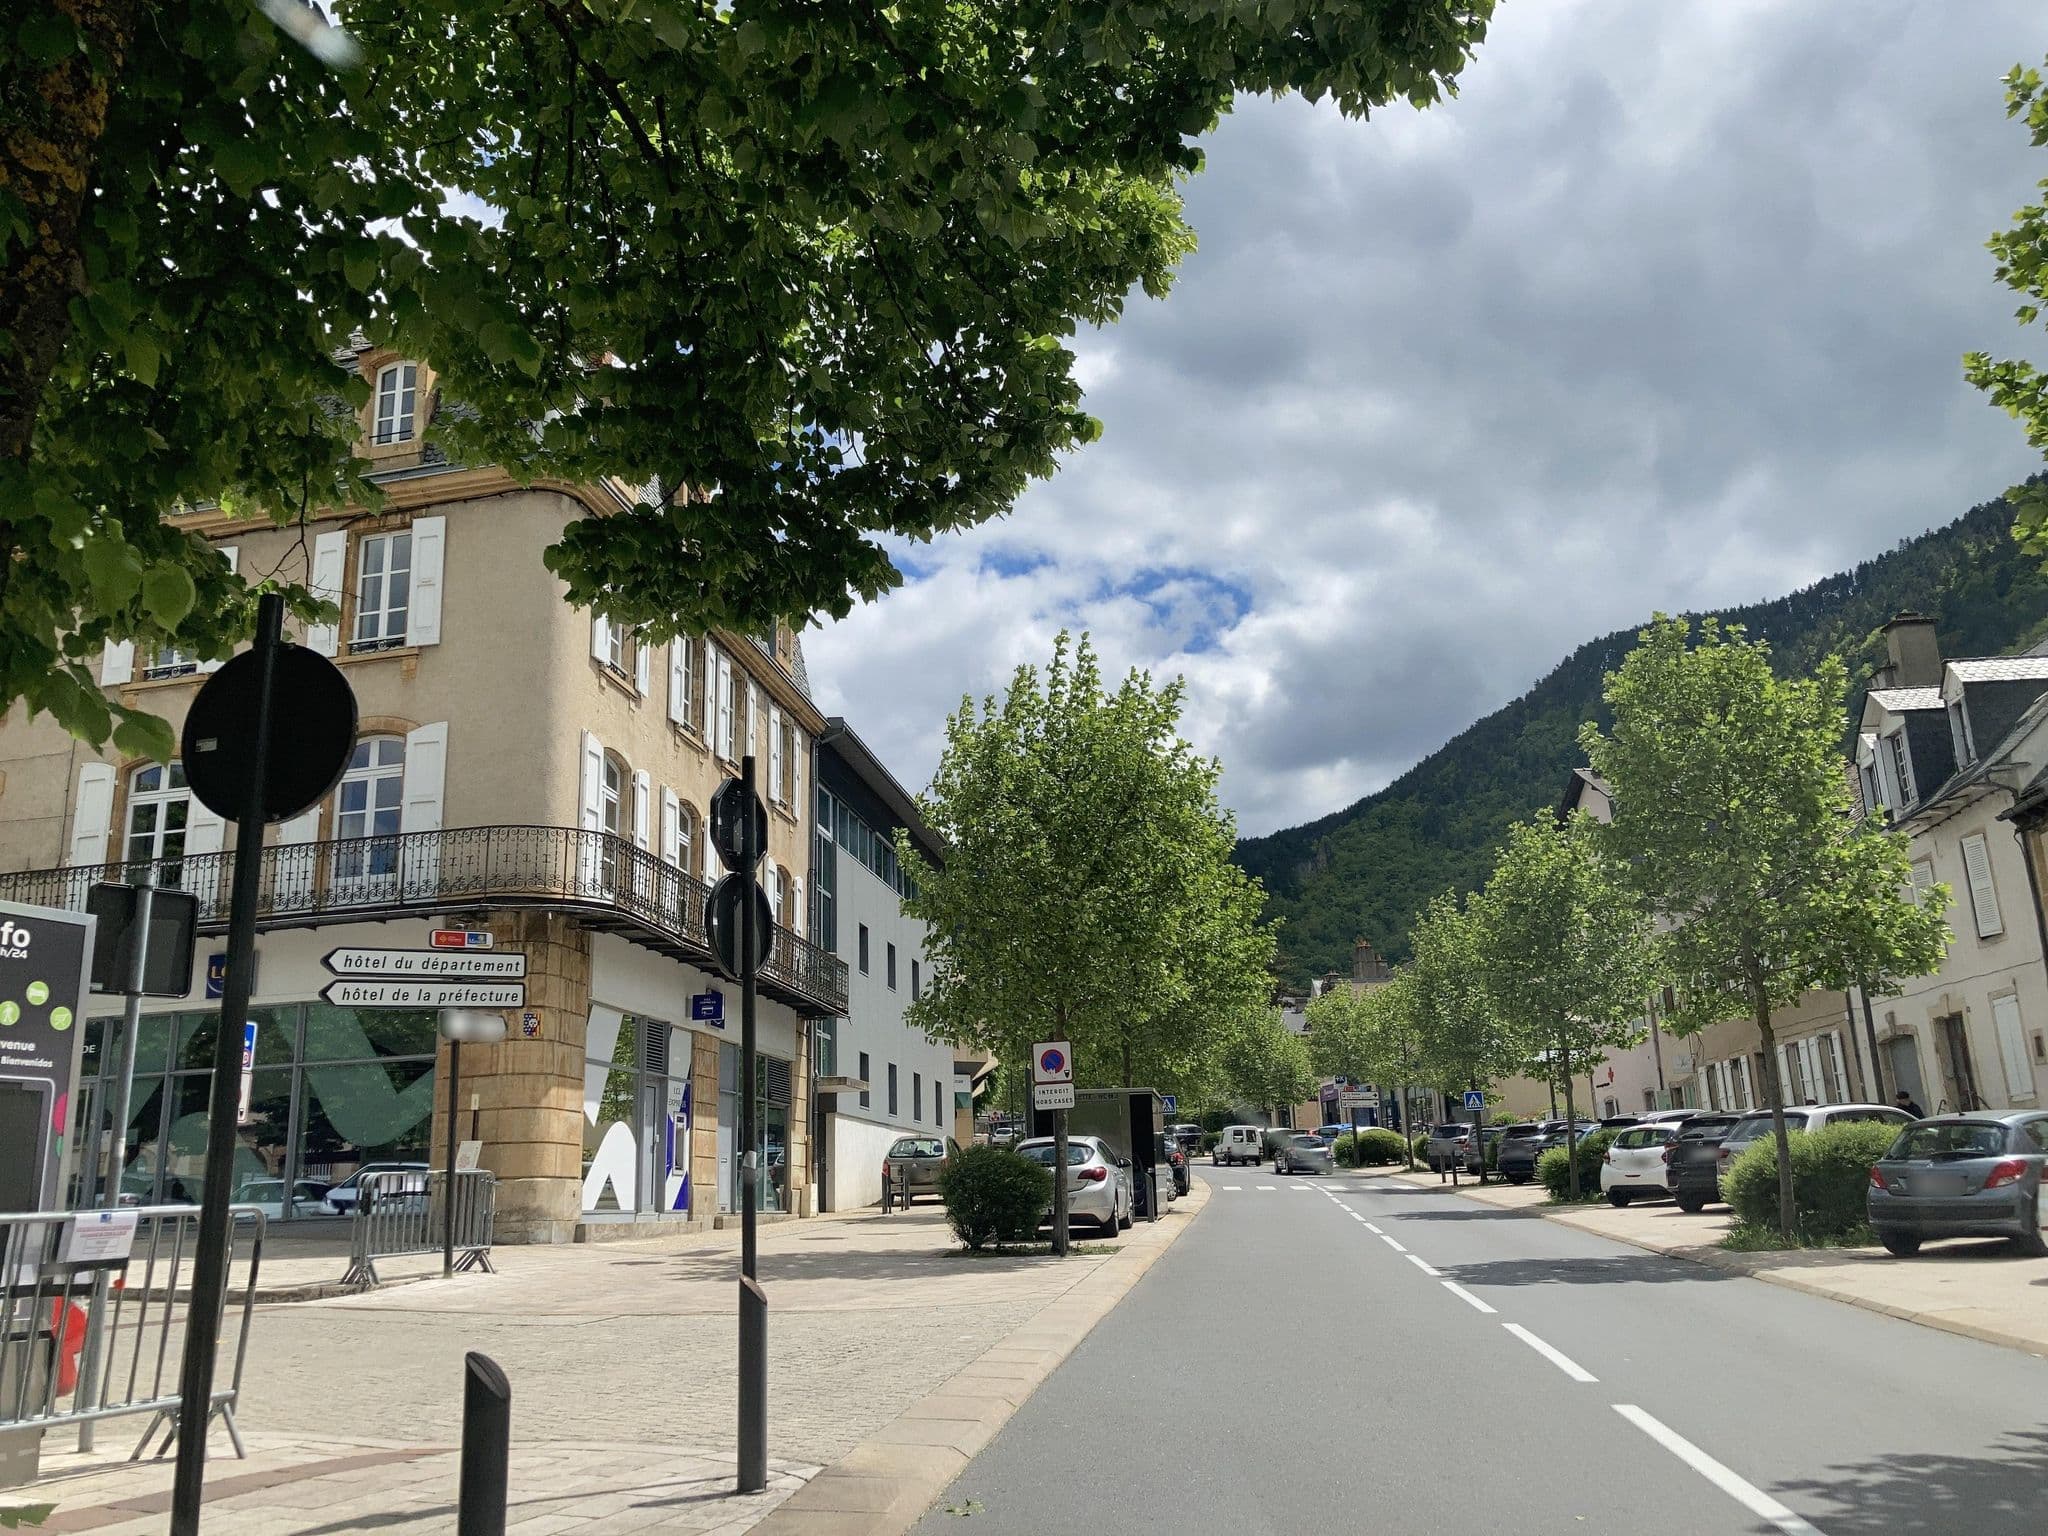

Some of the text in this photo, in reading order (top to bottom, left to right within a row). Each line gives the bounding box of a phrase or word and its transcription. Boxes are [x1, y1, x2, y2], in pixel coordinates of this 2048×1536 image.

[0, 921, 31, 948] fo
[344, 955, 521, 973] hôtel du département
[342, 988, 519, 1005] hôtel de la préfecture
[0, 1041, 36, 1051] venue
